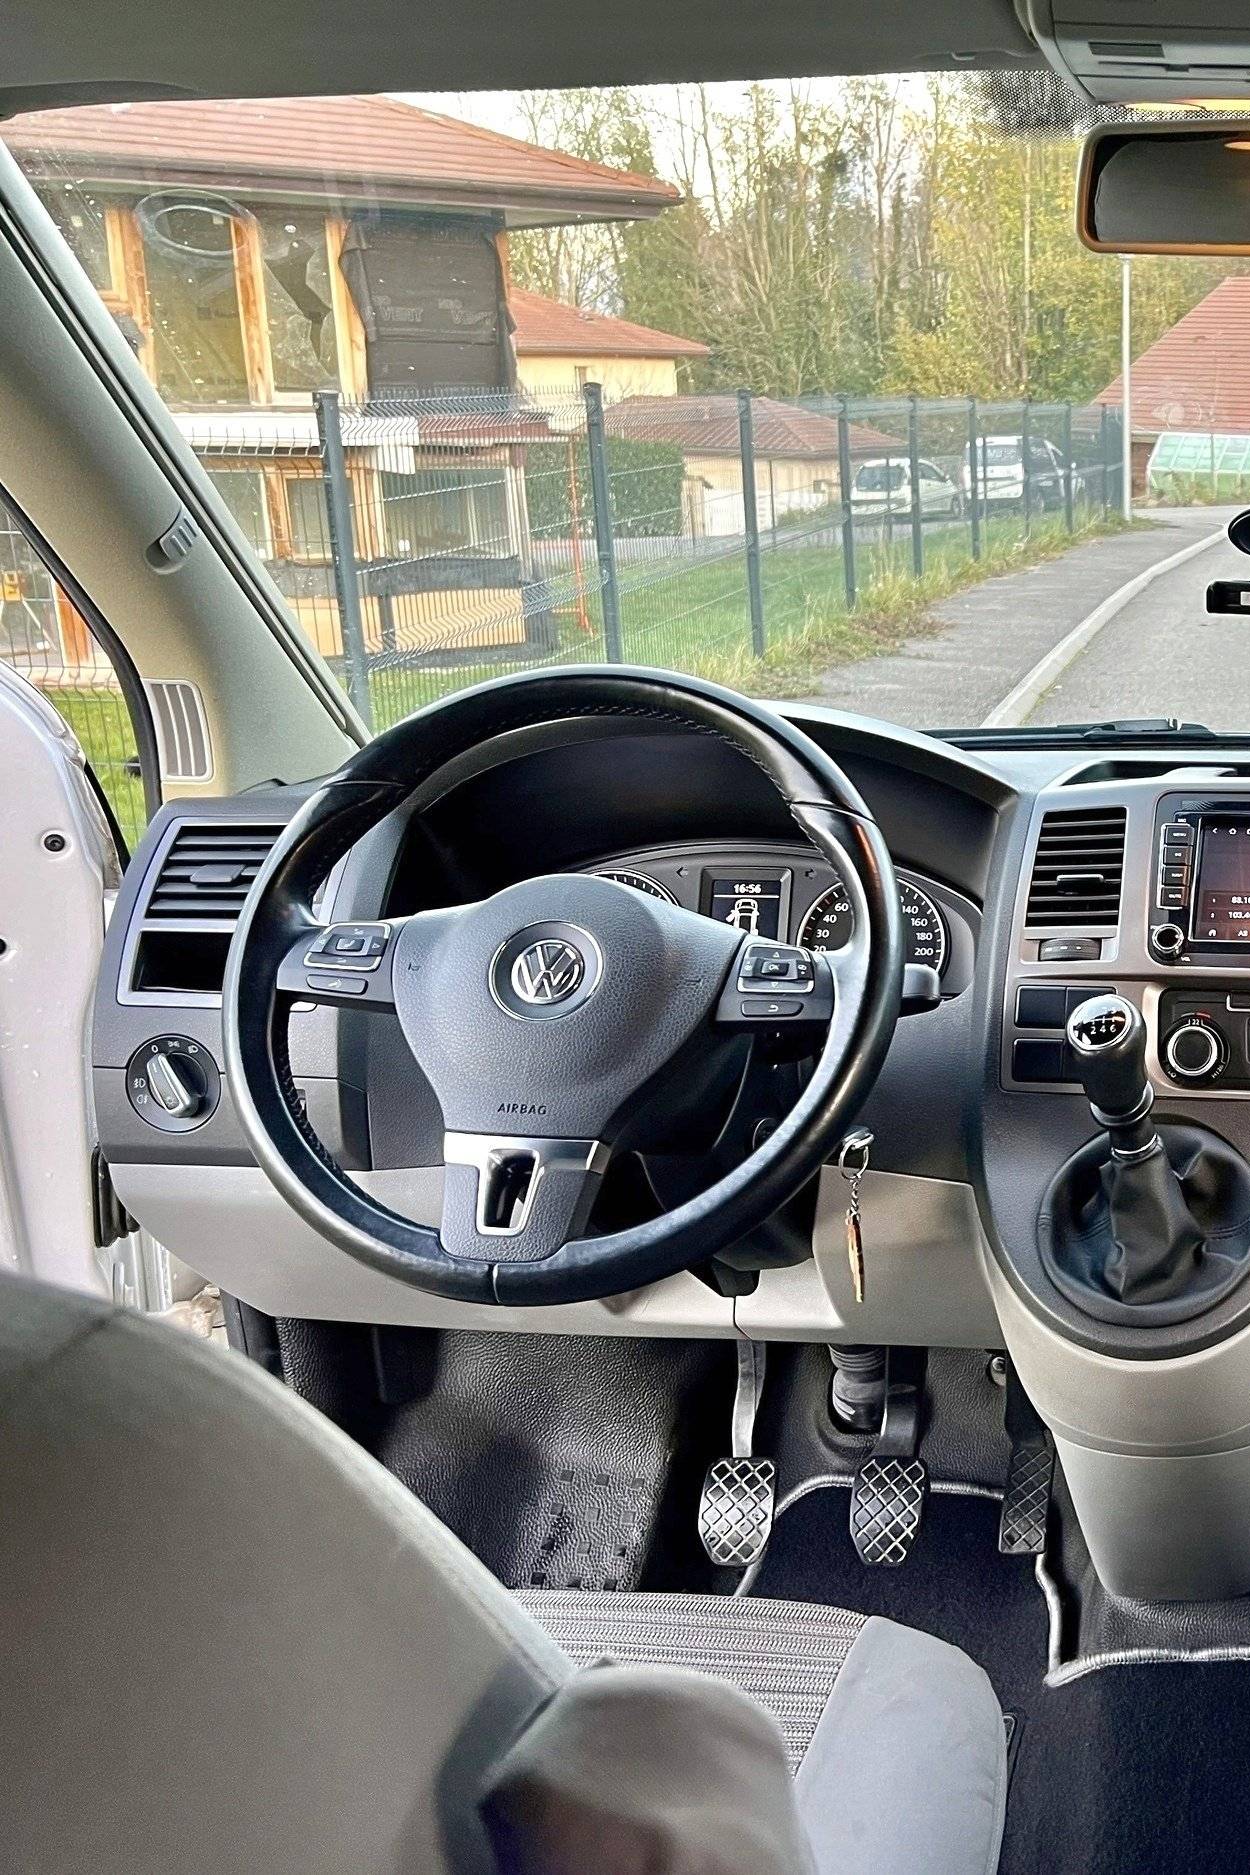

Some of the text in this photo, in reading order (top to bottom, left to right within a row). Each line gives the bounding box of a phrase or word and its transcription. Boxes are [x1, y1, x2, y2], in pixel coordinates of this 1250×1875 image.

[733, 883, 762, 894] 16:56
[834, 902, 849, 912] 60
[902, 905, 919, 915] 140
[822, 914, 837, 924] 40
[910, 918, 928, 927] 160
[816, 929, 830, 939] 30
[915, 932, 933, 941] 180
[813, 945, 827, 953] 20
[914, 947, 934, 957] 200
[497, 1103, 547, 1115] AIRBAG
